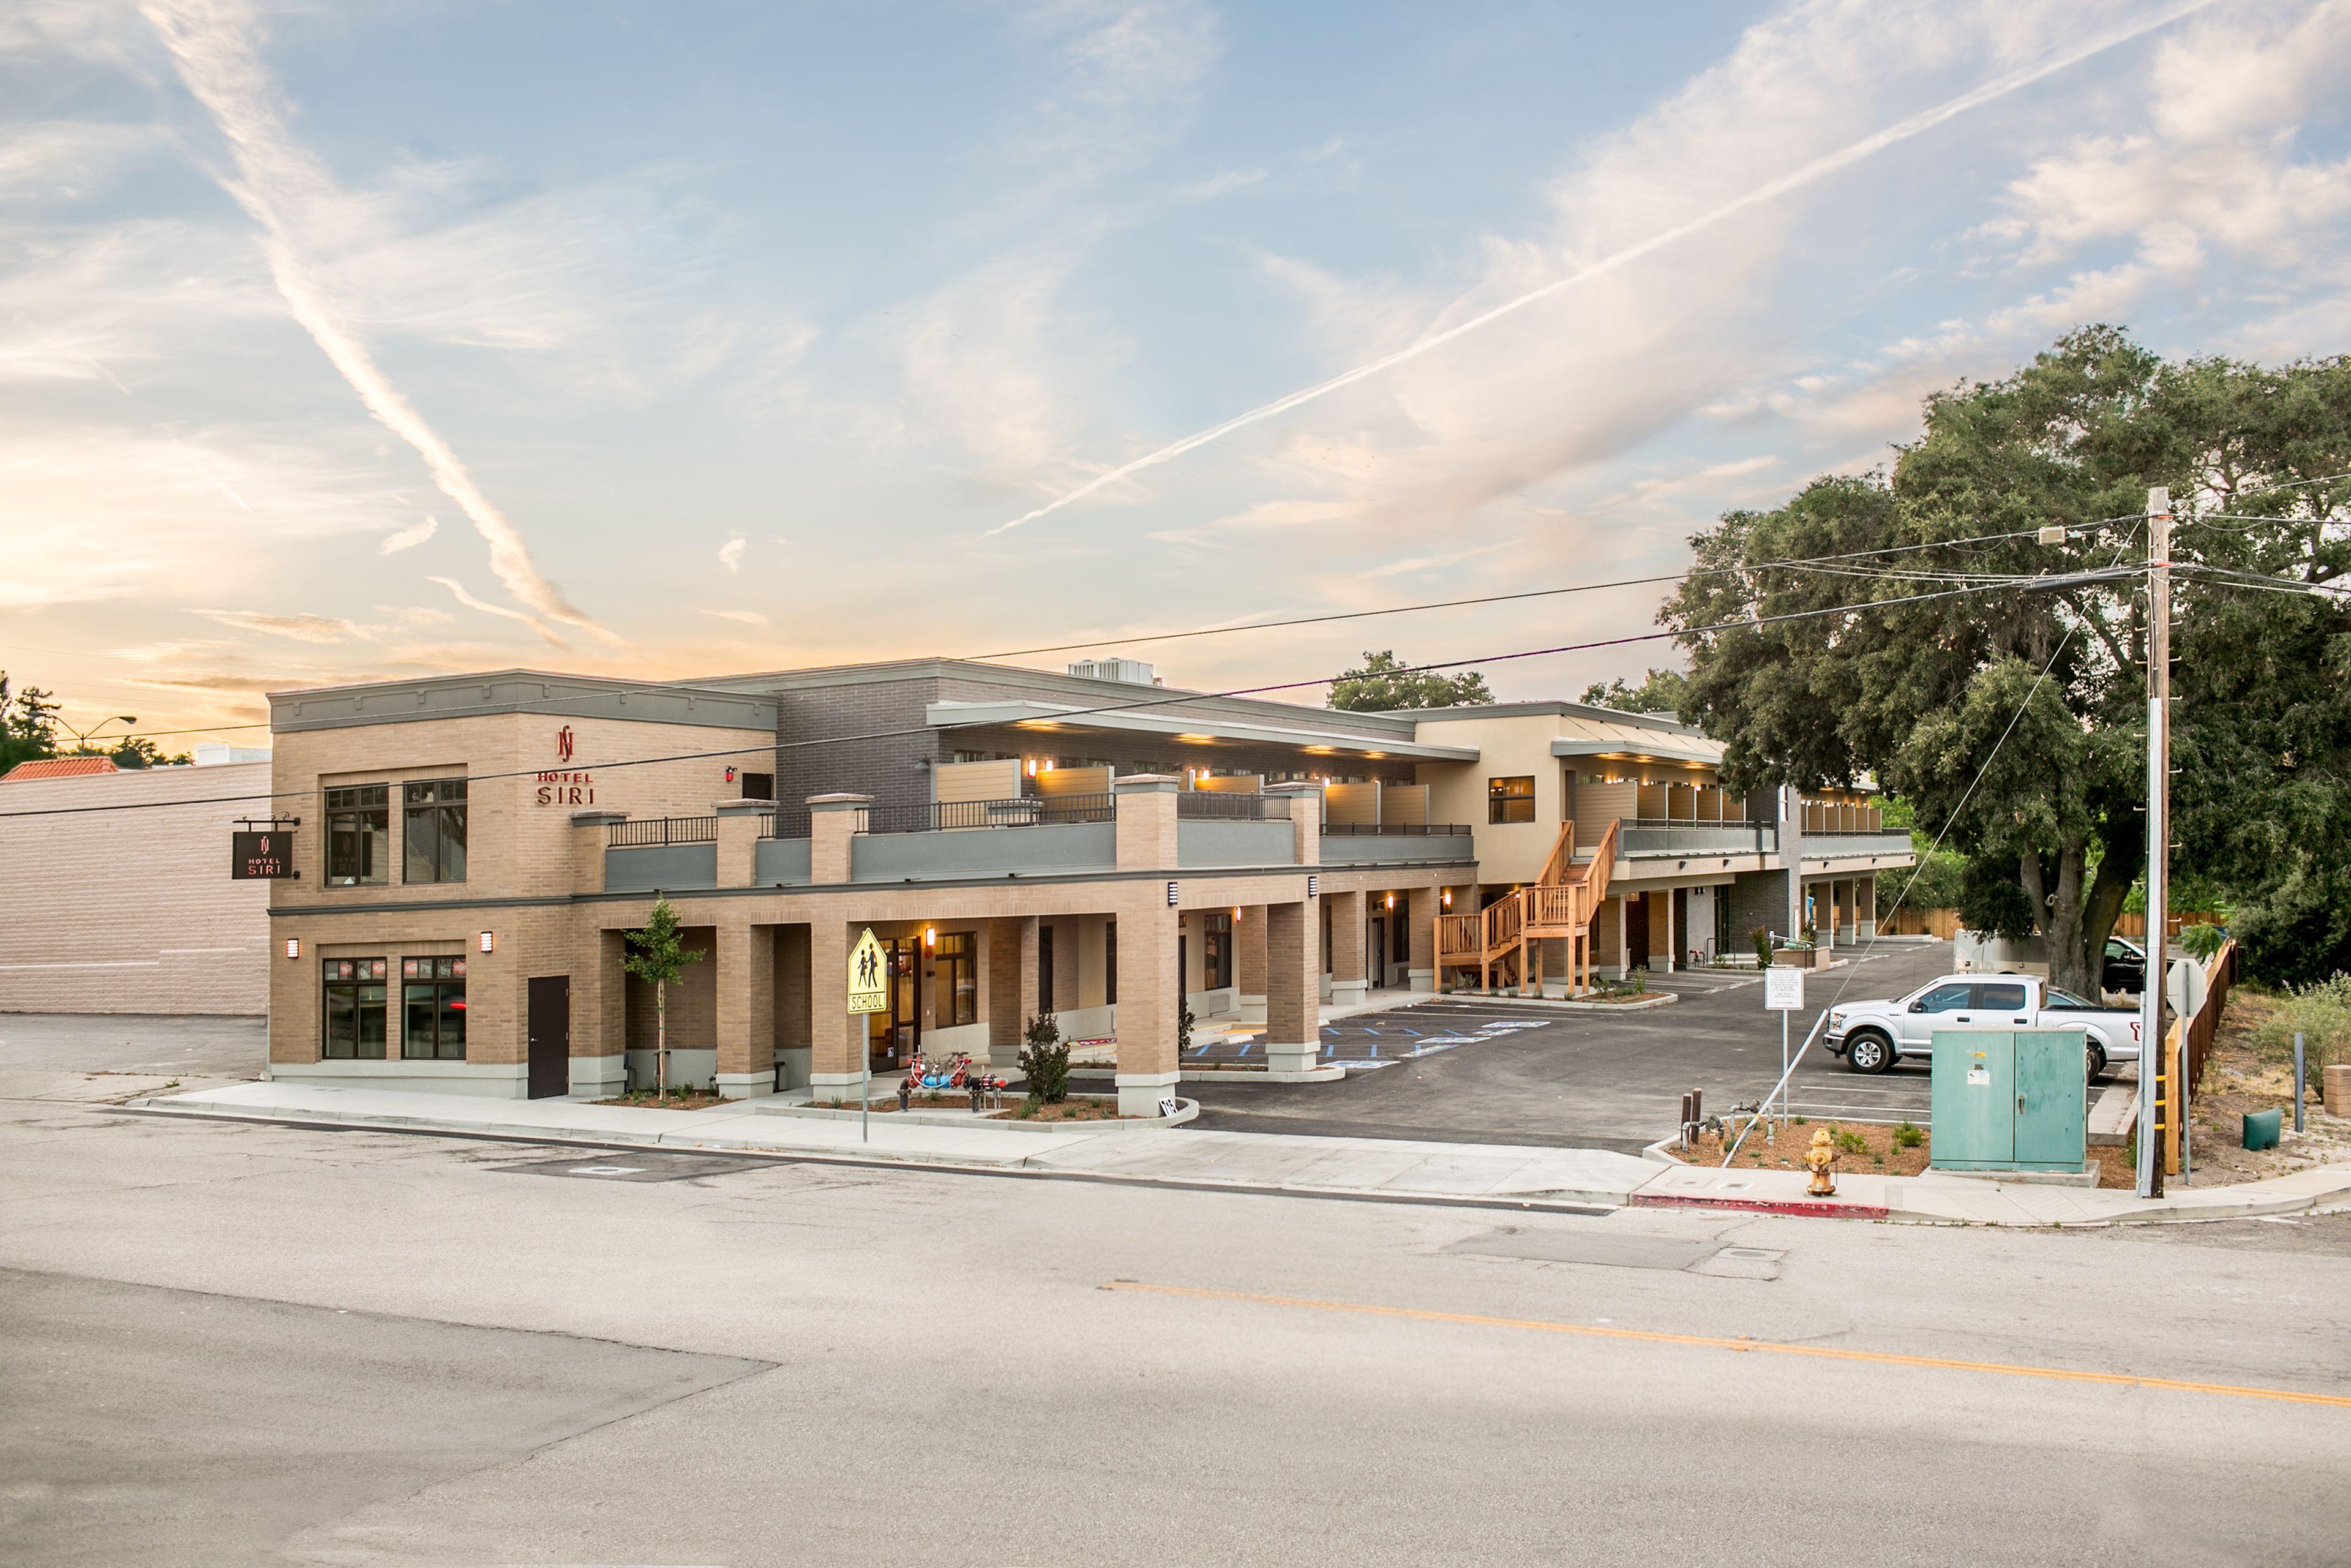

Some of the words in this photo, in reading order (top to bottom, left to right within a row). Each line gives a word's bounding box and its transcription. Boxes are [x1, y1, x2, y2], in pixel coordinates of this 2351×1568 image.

[538, 771, 594, 782] HOTEL
[538, 786, 594, 805] SIRI
[248, 865, 280, 875] SIRI
[852, 994, 882, 1009] SCHOOL
[1161, 1099, 1176, 1115] 715
